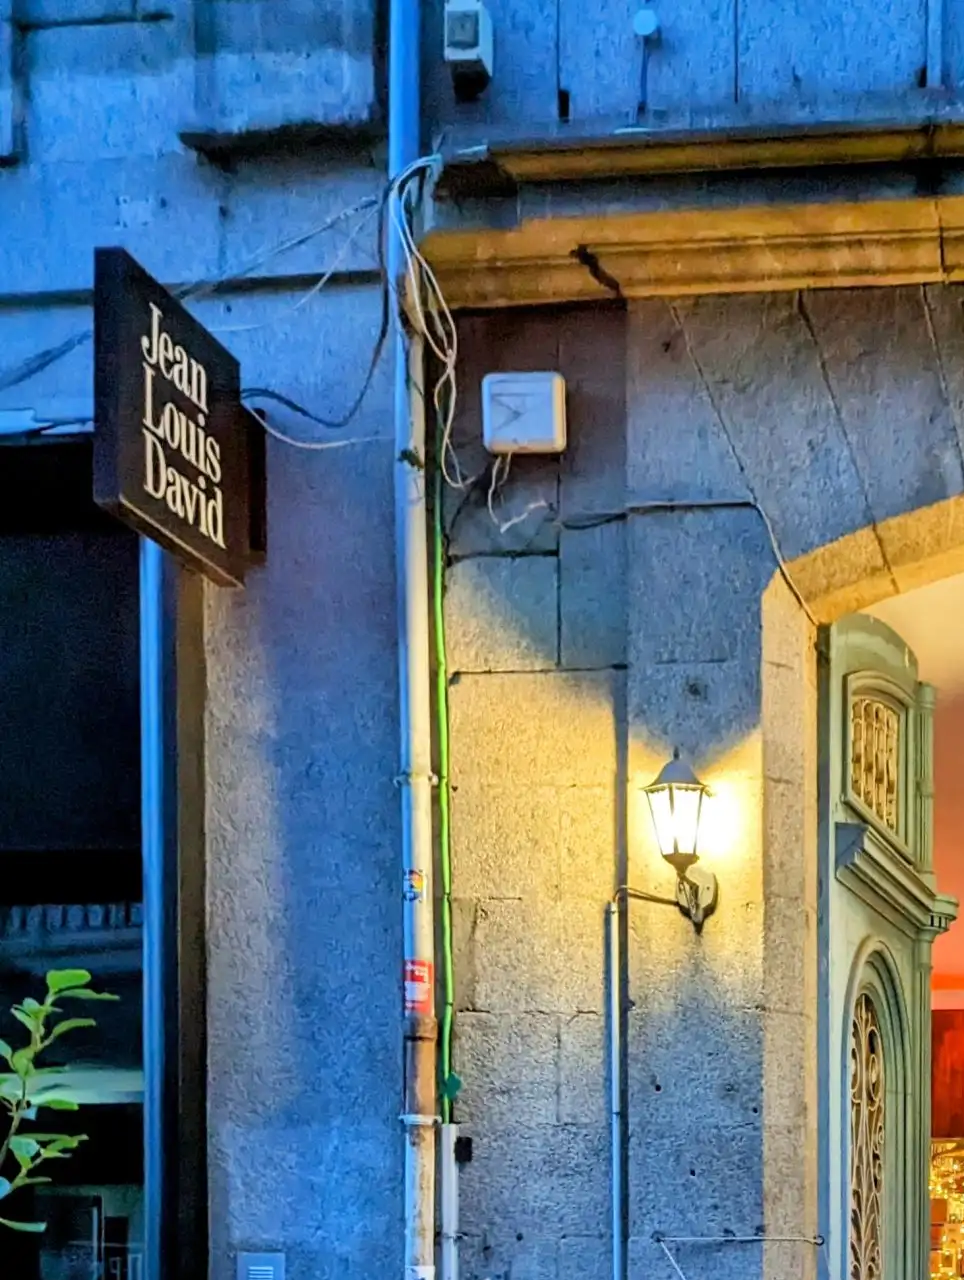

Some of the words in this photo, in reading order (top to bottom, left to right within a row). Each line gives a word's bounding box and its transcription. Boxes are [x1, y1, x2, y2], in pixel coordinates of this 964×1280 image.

[141, 302, 208, 414] Jean
[143, 362, 221, 483] Louis
[143, 428, 227, 549] David
